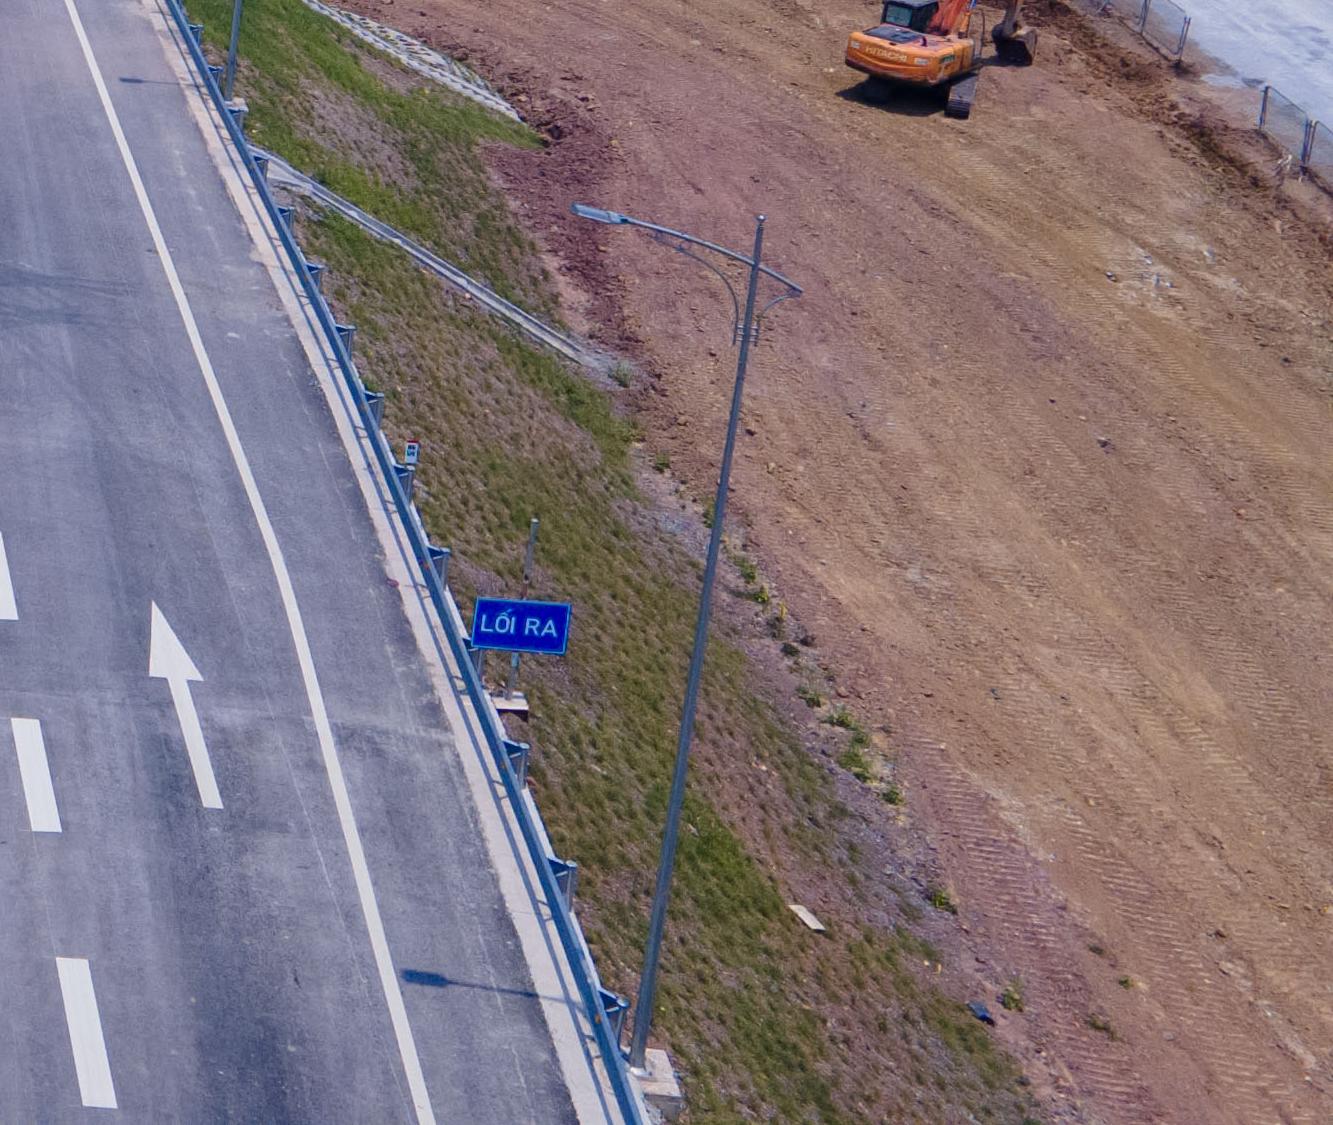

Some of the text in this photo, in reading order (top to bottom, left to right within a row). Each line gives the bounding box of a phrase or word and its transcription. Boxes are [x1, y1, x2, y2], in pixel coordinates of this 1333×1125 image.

[865, 46, 908, 62] HITACHI
[480, 608, 558, 638] LỐI RA
